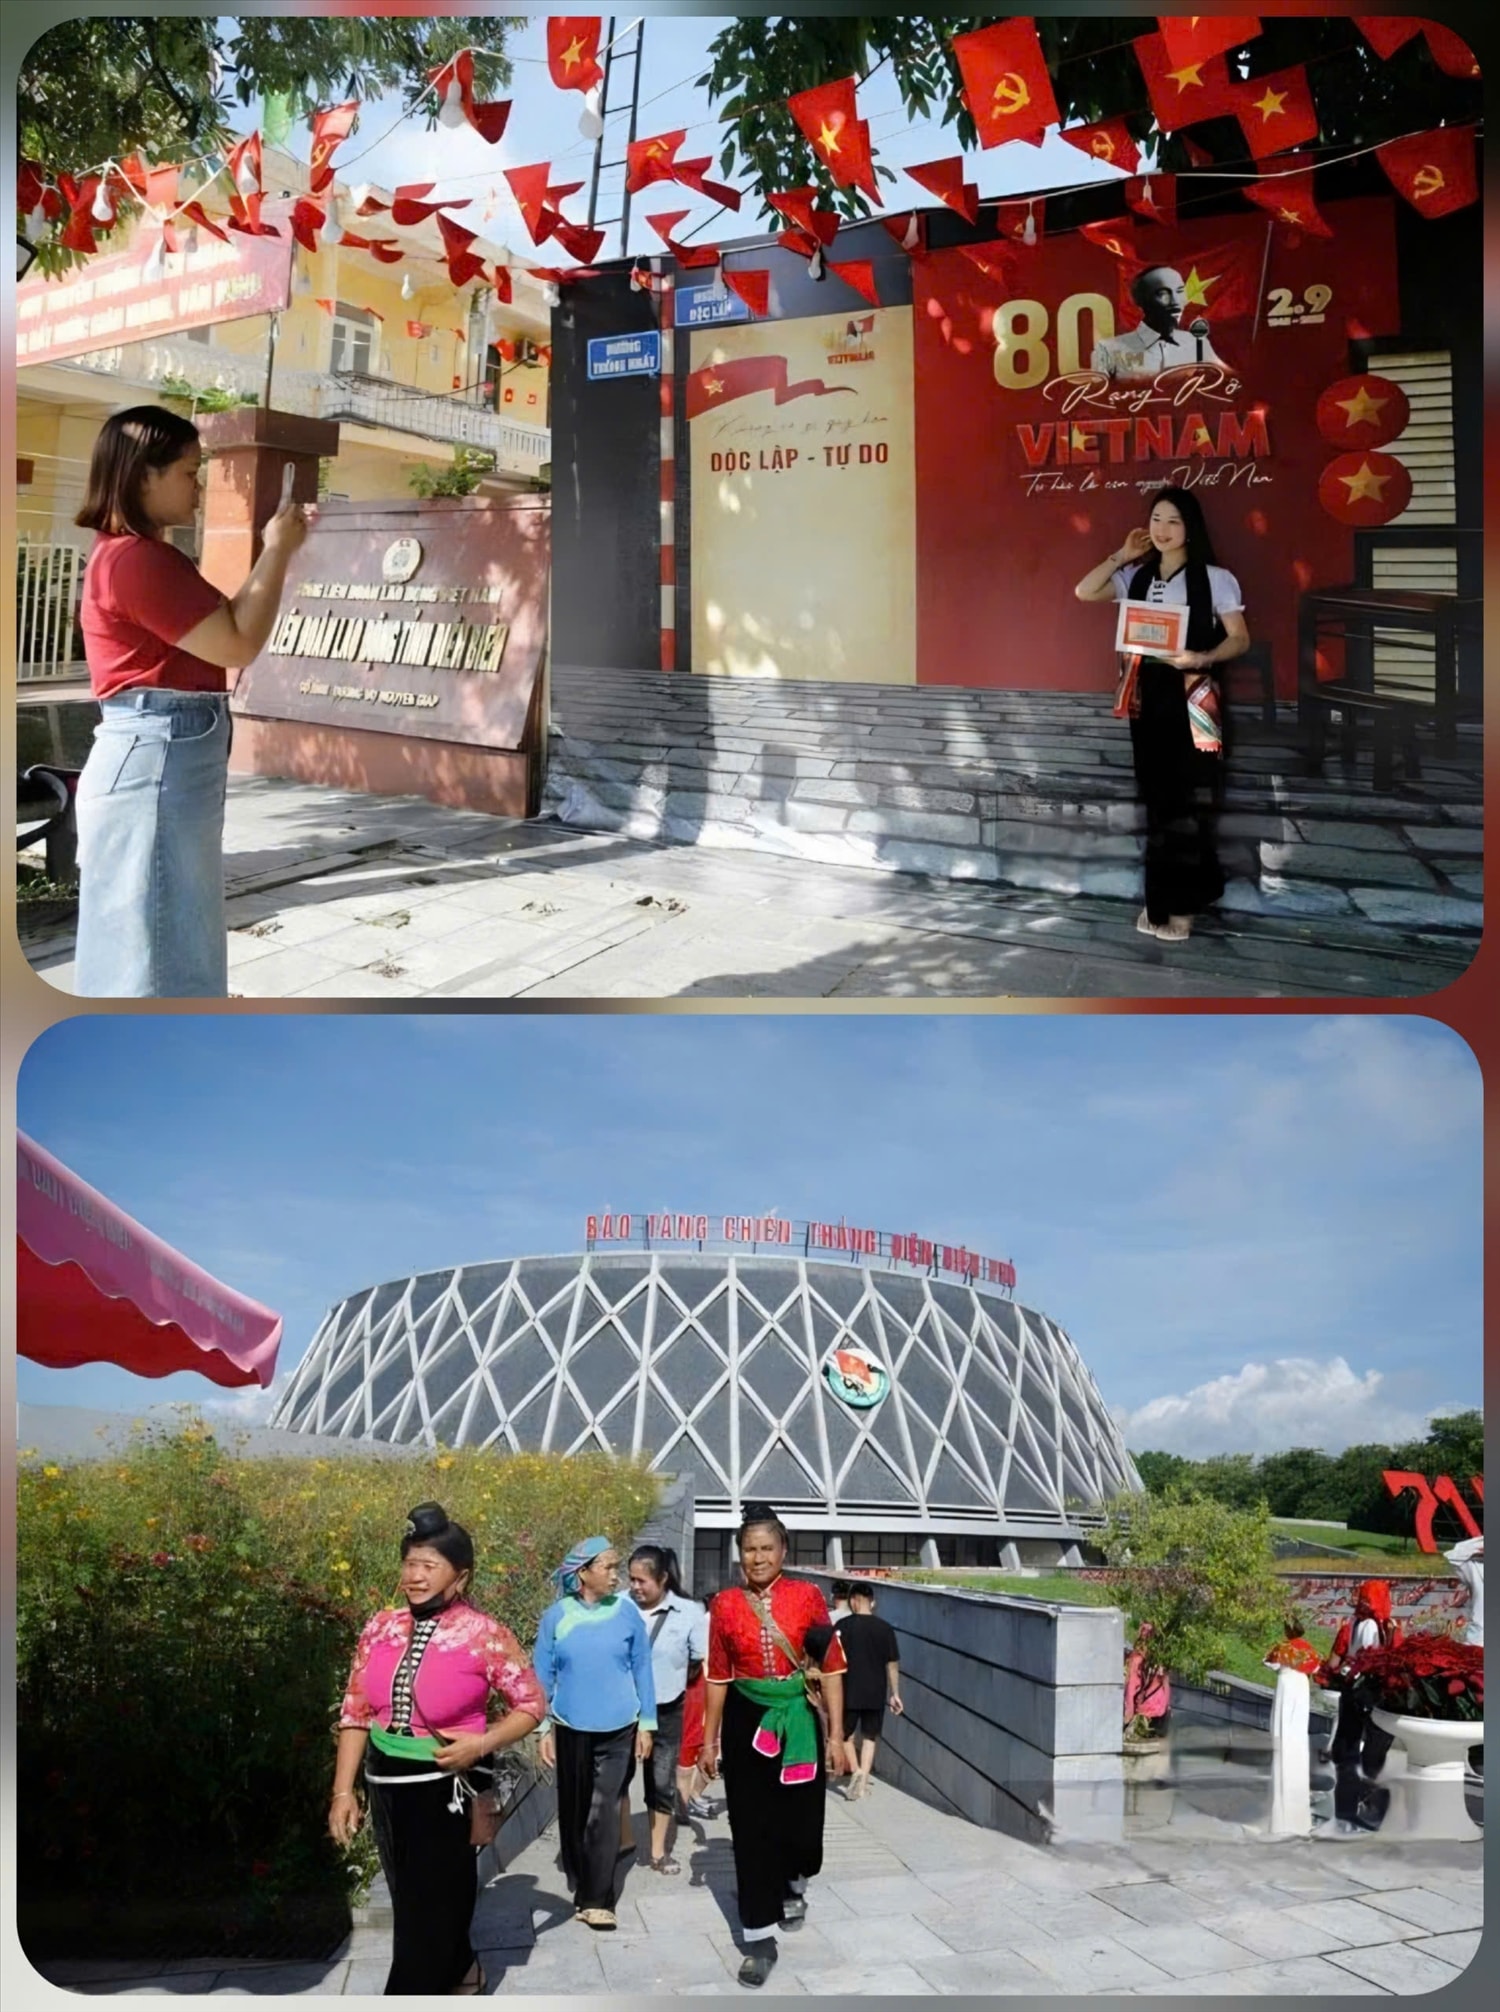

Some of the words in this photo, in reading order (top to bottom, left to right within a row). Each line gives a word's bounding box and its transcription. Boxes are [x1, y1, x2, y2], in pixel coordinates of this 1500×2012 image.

[1267, 284, 1332, 317] 2.9
[992, 293, 1116, 389] 80
[1016, 410, 1271, 466] VIETNAM
[759, 444, 799, 474] LẬP
[823, 443, 852, 470] TỰ
[858, 442, 888, 464] DO
[647, 1206, 709, 1242] TÀNG
